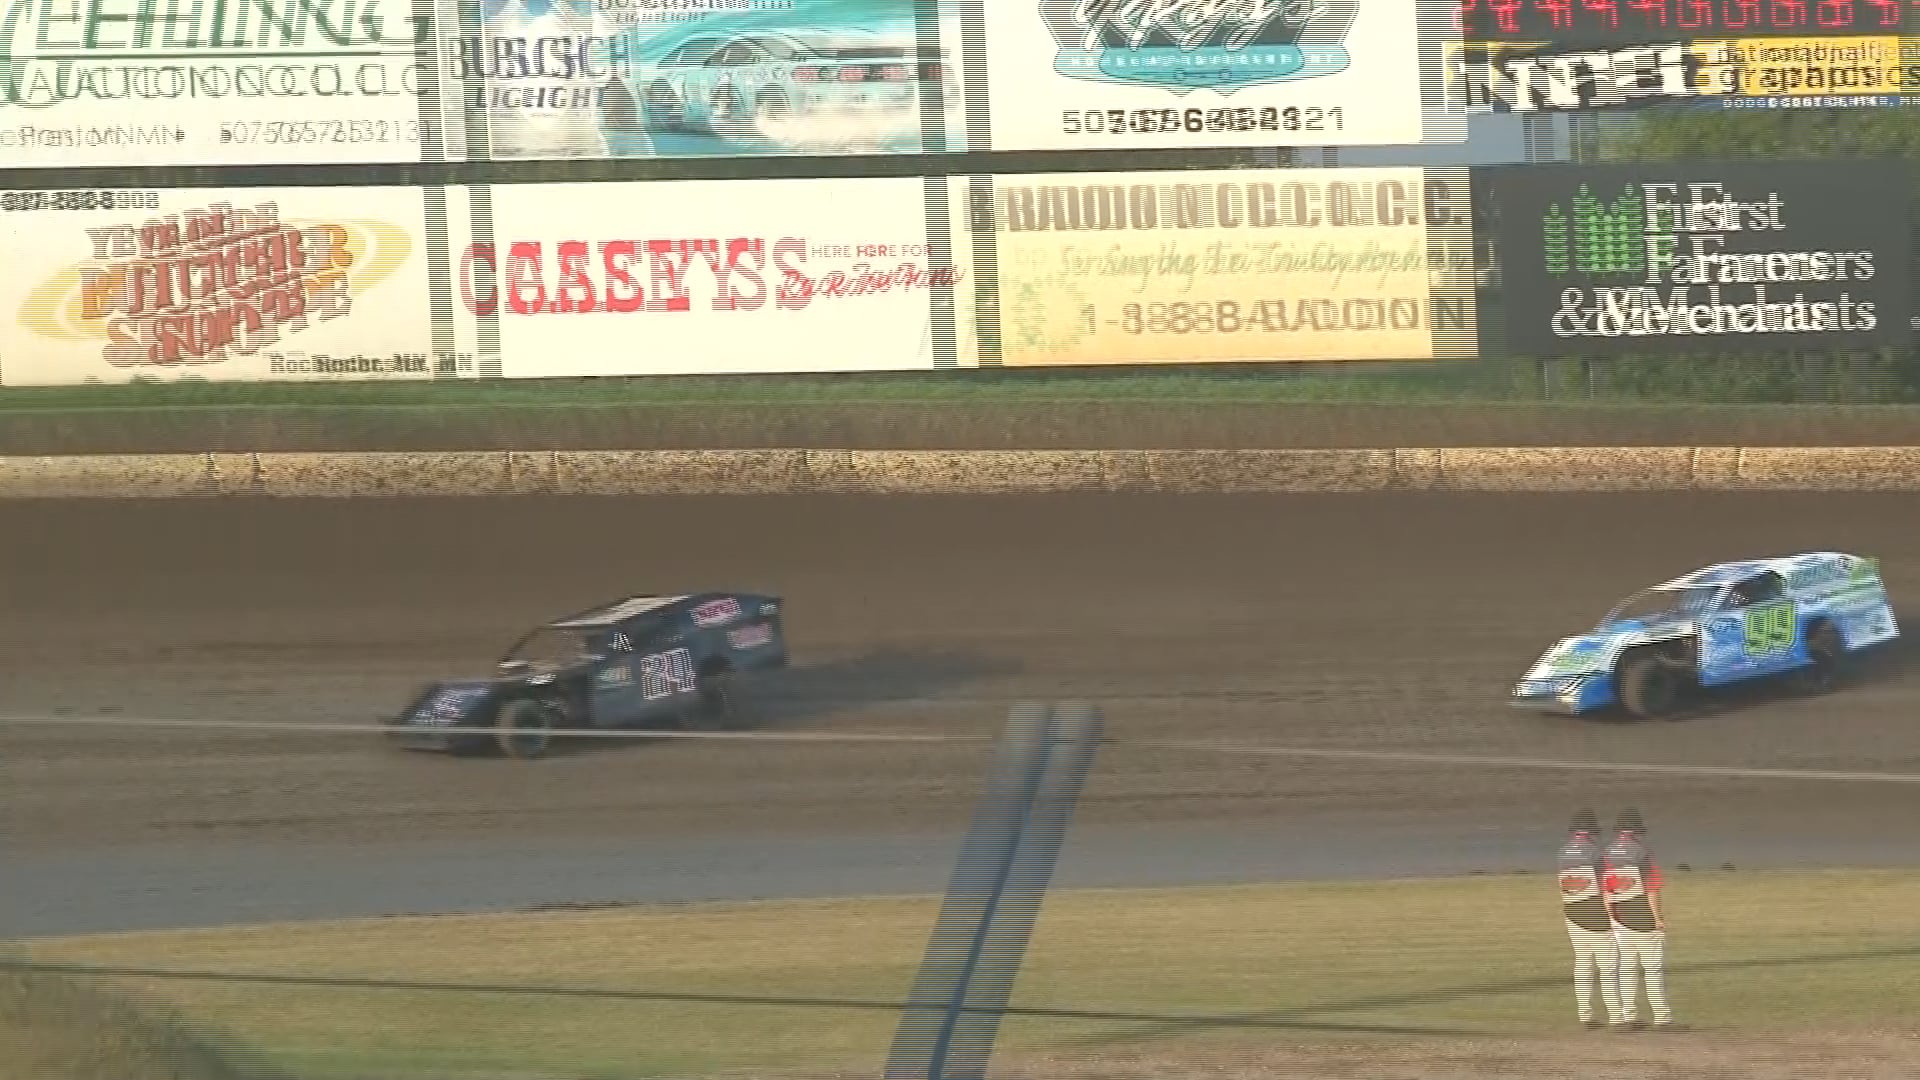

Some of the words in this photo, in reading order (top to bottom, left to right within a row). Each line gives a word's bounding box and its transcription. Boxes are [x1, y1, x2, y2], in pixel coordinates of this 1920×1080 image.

[27, 64, 264, 100] AUCTION
[447, 32, 631, 82] BUSCH
[1460, 40, 1734, 114] NFG
[1720, 59, 1920, 95] graphics
[475, 84, 607, 110] LIGHT
[1062, 106, 1344, 135] 507-696-4821
[219, 120, 432, 146] 507-765-2131
[0, 189, 160, 211] 507-282-5908
[962, 181, 1203, 234] BAUDOIN
[1642, 181, 1785, 234] First
[80, 223, 354, 320] BUTCHER
[460, 236, 812, 317] CASEY'S
[1058, 244, 1197, 294] Serving
[1645, 233, 1874, 286] Farmers
[103, 271, 352, 368] SHOPPE
[1080, 296, 1465, 336] 1-888-BAUDOIN
[270, 352, 431, 376] Rochester,
[1745, 600, 1799, 658] 99
[640, 646, 696, 700] 24
